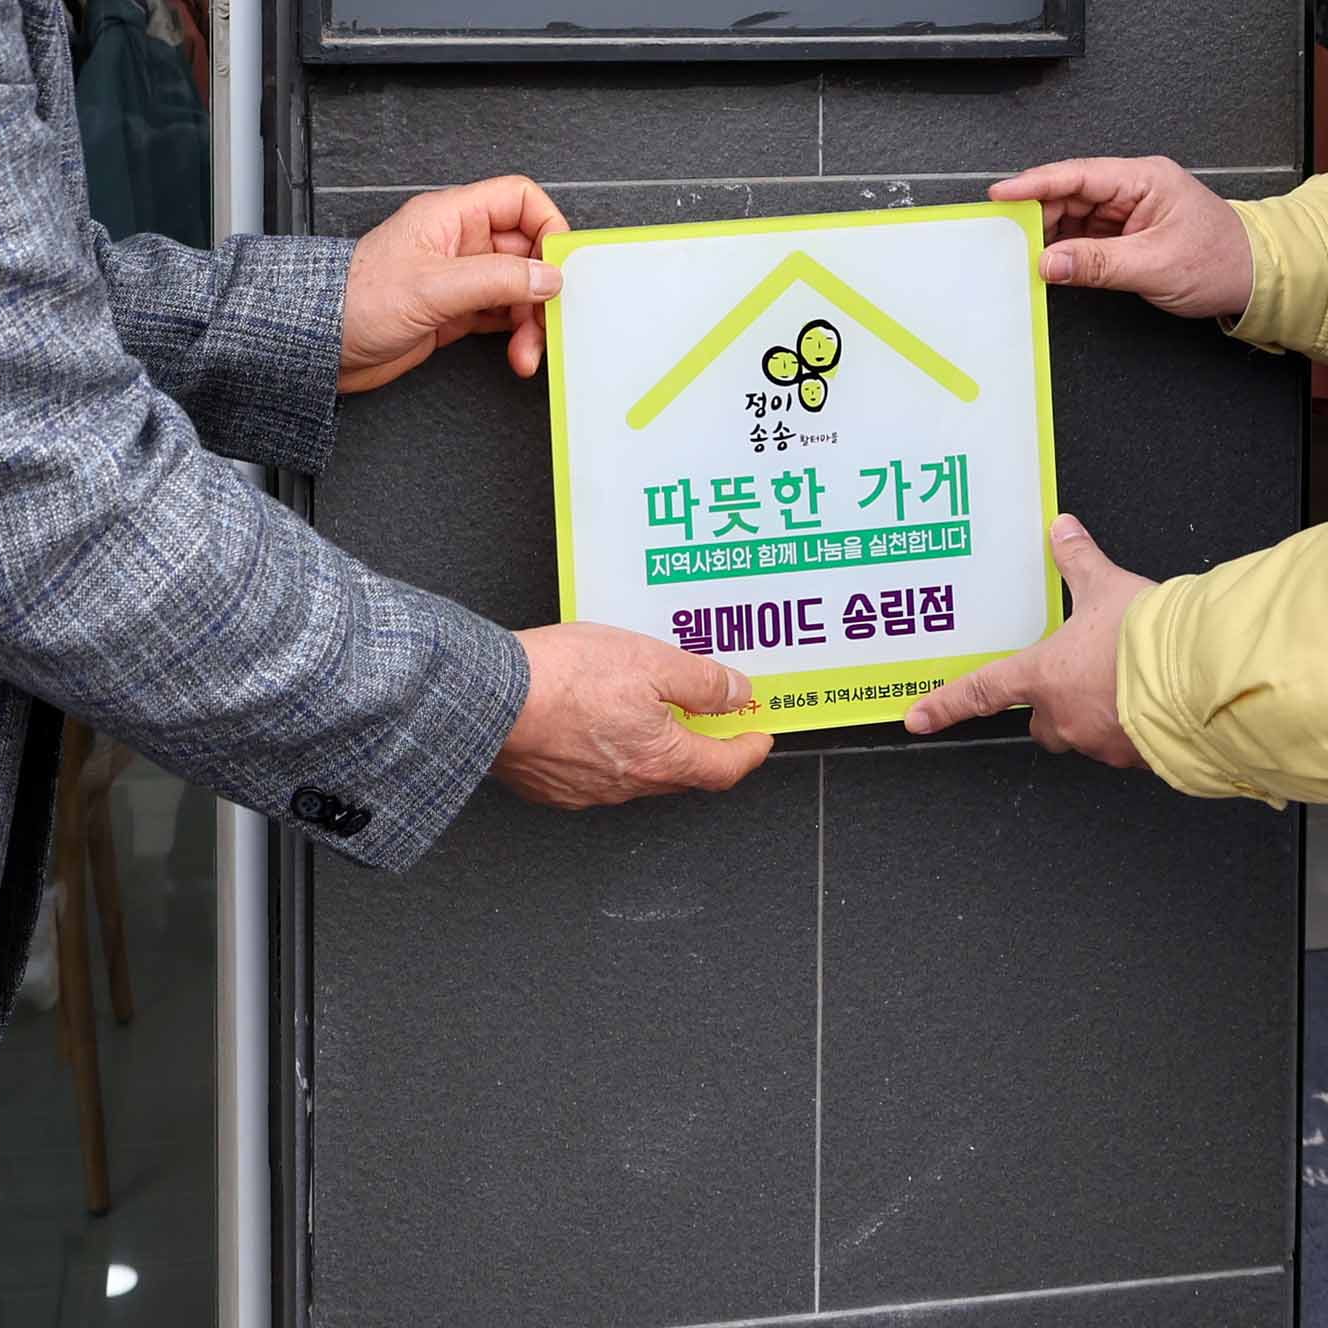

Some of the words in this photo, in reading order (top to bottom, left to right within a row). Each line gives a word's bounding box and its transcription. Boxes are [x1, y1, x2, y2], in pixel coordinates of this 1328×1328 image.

[745, 391, 792, 418] 정이
[750, 420, 797, 453] 송송
[643, 467, 826, 540] 따뜻한
[858, 454, 970, 521] 가게
[651, 546, 752, 576] 지역사회와
[757, 543, 797, 567] 함께
[803, 536, 863, 563] 나눔을
[868, 526, 968, 557] 실천합니다
[672, 597, 827, 655] 웰메이드
[842, 584, 955, 640] 송림점
[769, 691, 819, 710] 송림6동
